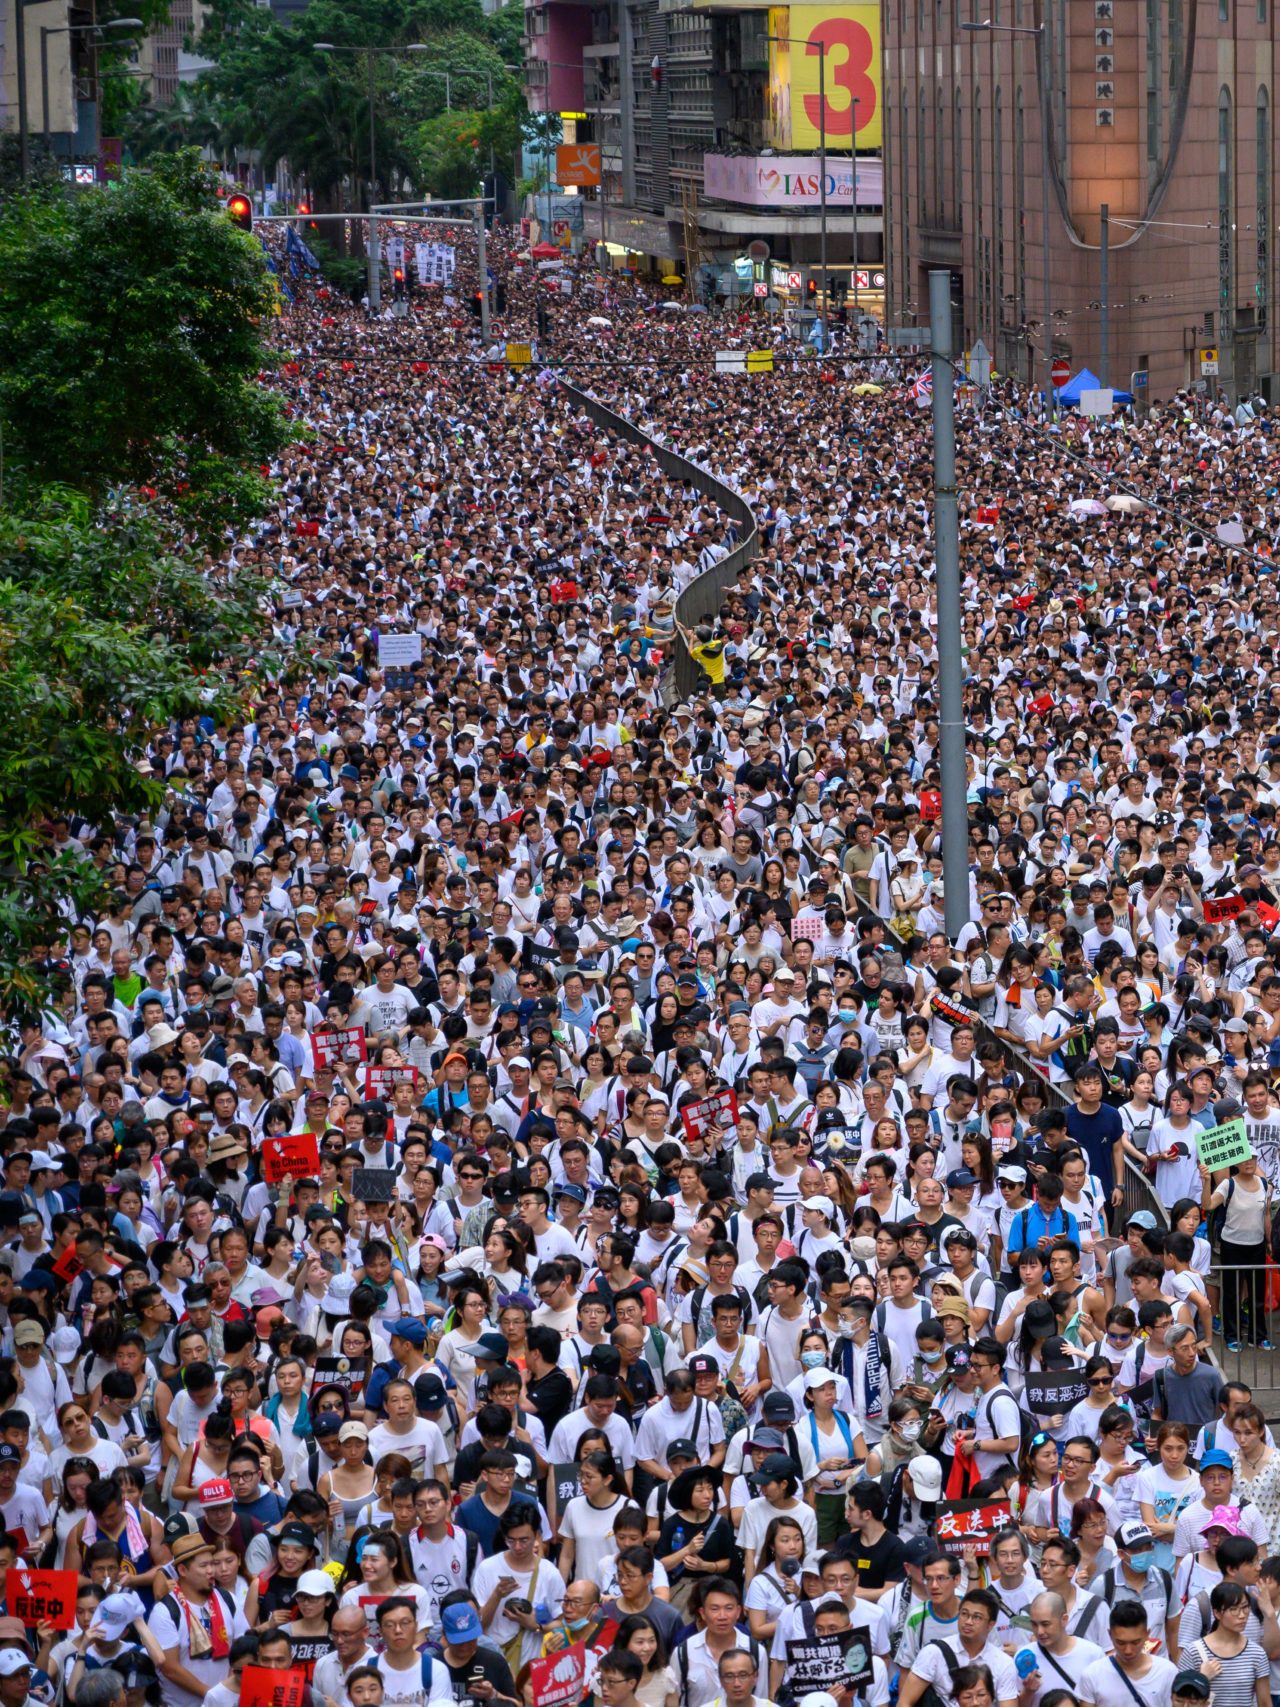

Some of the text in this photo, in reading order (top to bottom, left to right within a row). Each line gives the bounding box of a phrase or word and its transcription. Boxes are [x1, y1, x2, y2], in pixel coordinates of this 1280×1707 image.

[804, 17, 877, 136] 3
[784, 175, 836, 196] IASO
[270, 1157, 308, 1169] No China
[1077, 1220, 1092, 1231] UMA
[203, 1485, 225, 1496] BULLS
[937, 1509, 1010, 1538] 反送中
[15, 1596, 64, 1620] 反送中
